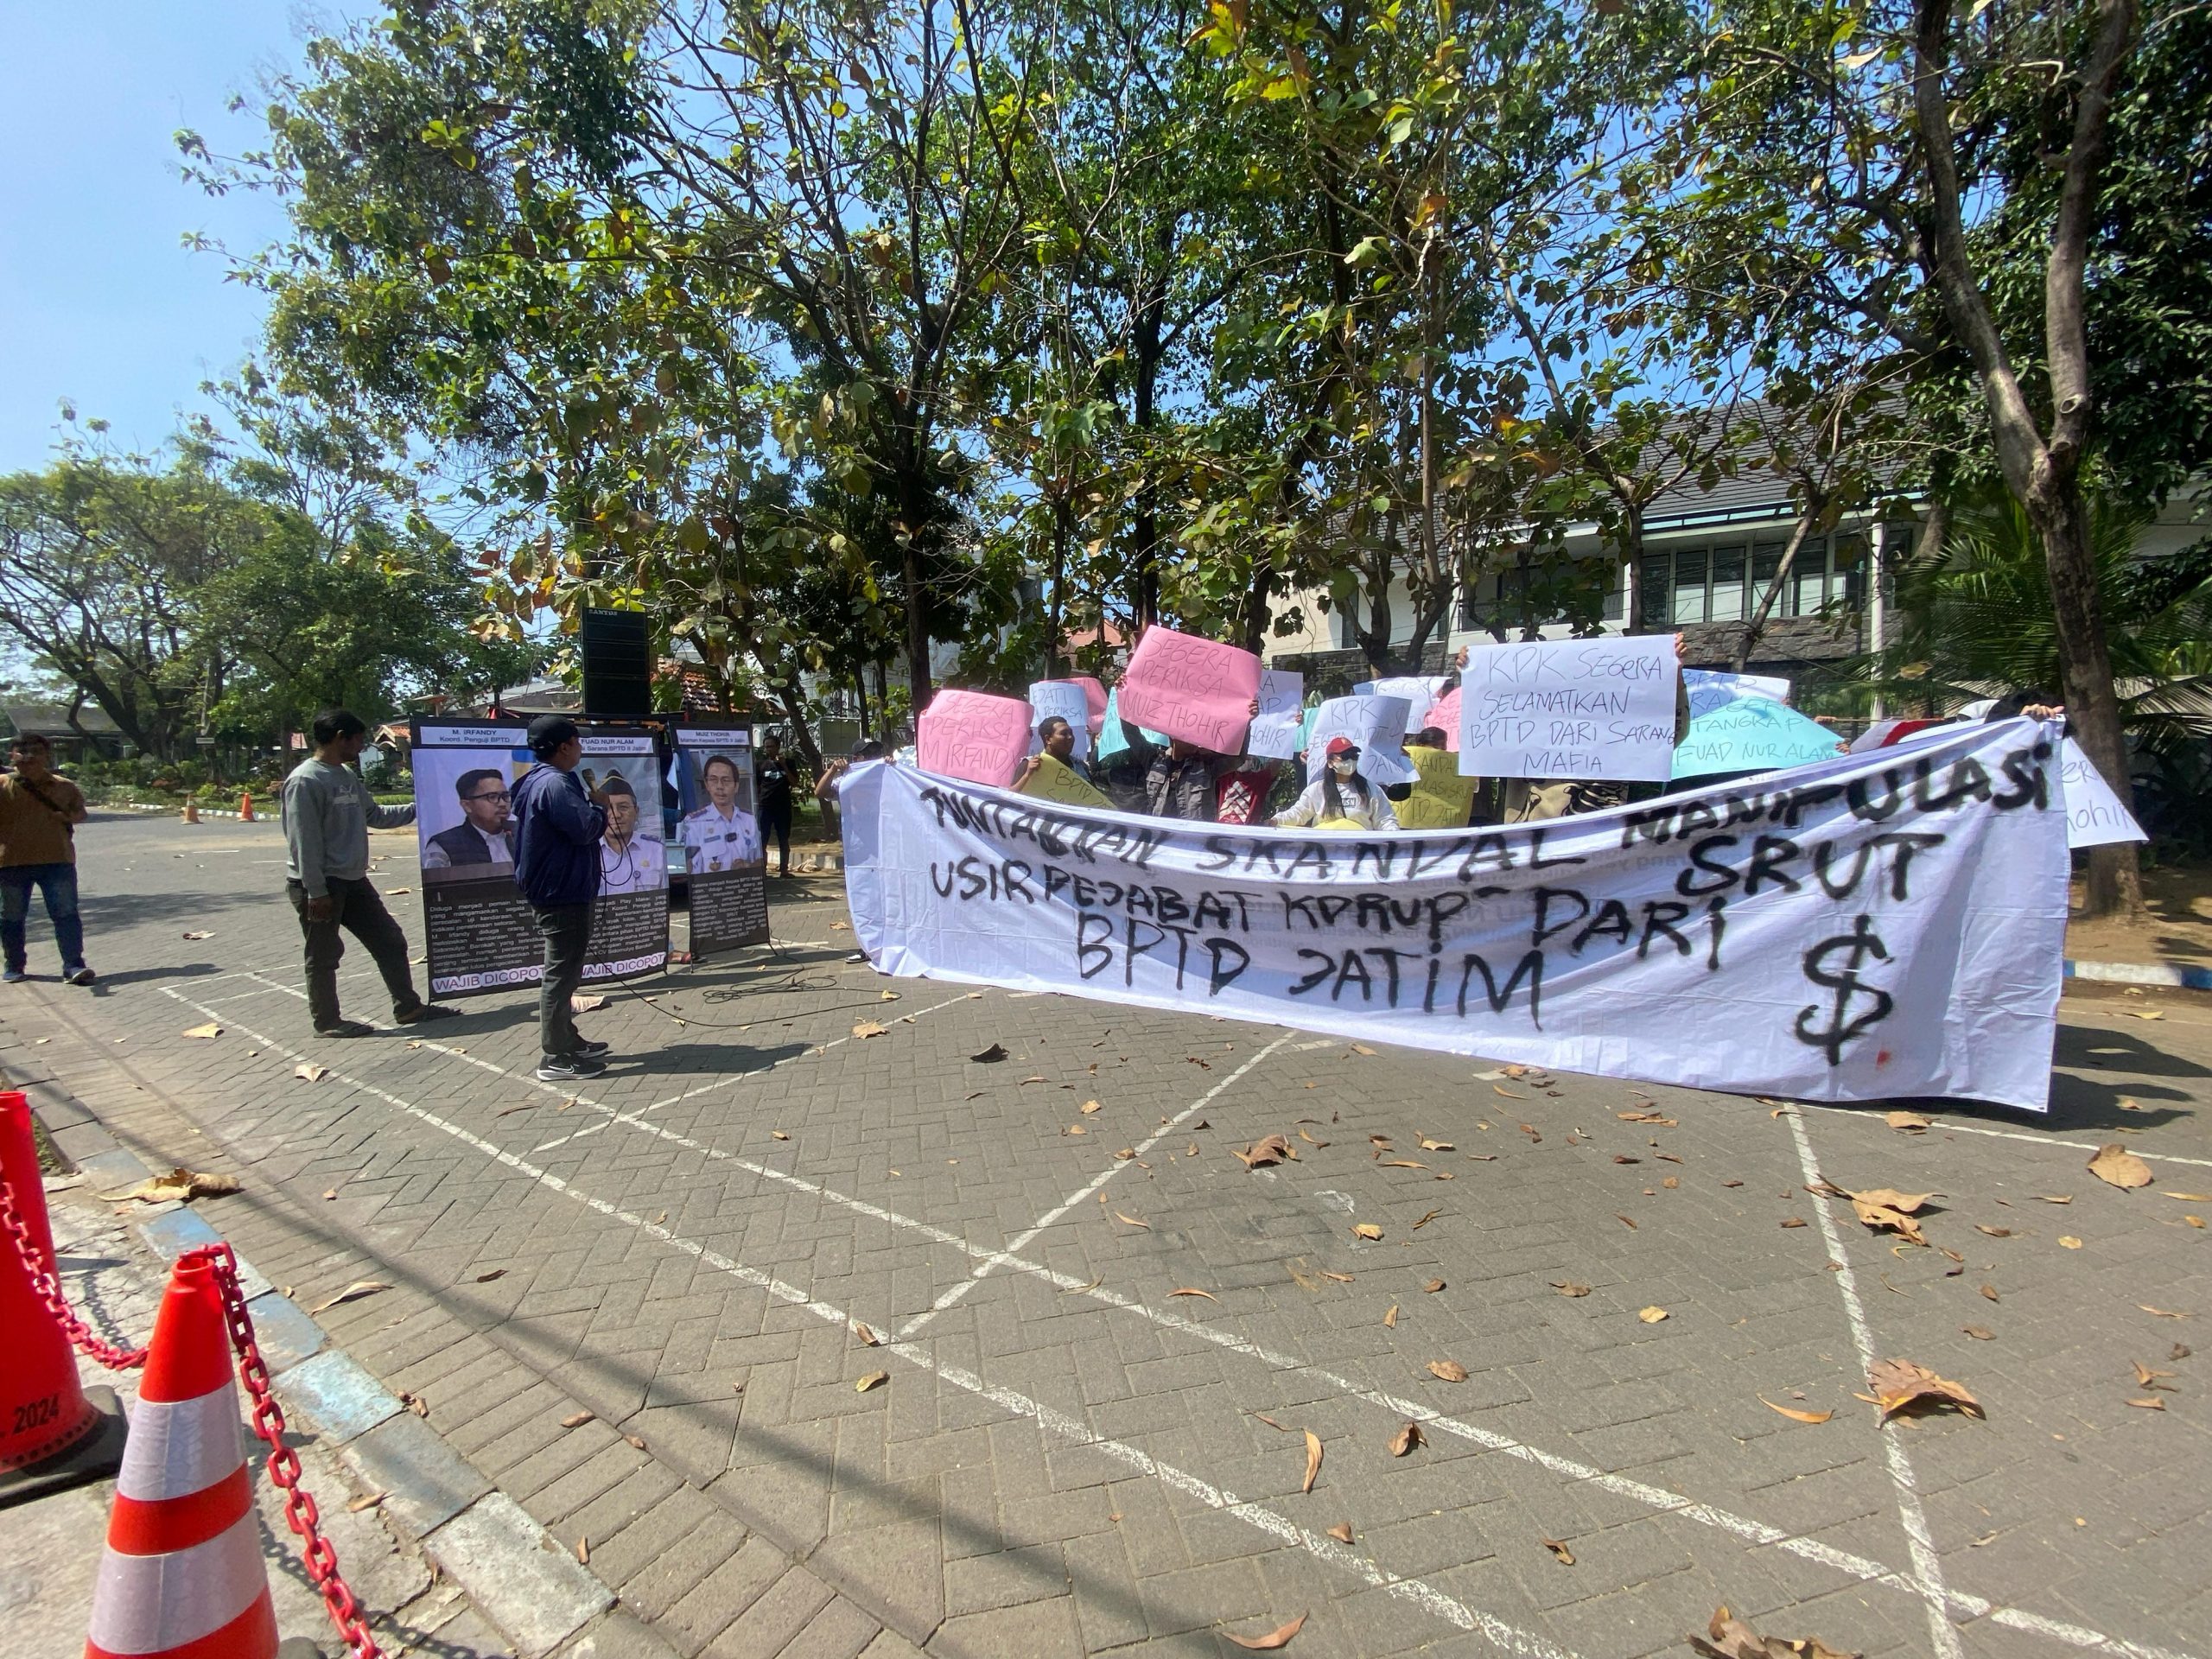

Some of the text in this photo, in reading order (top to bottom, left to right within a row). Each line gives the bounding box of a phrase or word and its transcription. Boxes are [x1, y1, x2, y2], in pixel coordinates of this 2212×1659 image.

[1144, 632, 1233, 675] SEGERA
[1489, 646, 1567, 683] KPK
[1140, 660, 1224, 699] PERIKSA
[939, 693, 1014, 722] SEGERA
[1331, 698, 1377, 727] KPK
[1479, 687, 1630, 721] SELAMATKAN
[930, 716, 1012, 741] PERIKSA
[1166, 702, 1230, 745] THOHIR
[1471, 716, 1535, 749] BPTD
[1605, 721, 1676, 745] SARANG
[1690, 715, 1804, 734] TANGKAP
[1524, 751, 1602, 776] MAFIA
[1676, 741, 1834, 766] FUAD NUR ALAM
[1676, 832, 1947, 902] SRUT
[931, 855, 1034, 904] USIR
[1044, 865, 1263, 932] PEJABAT
[616, 955, 664, 972] DICOPOT
[1077, 913, 1251, 996] BPTD
[435, 976, 480, 990] WAJIB
[13, 1394, 60, 1435] 2024
